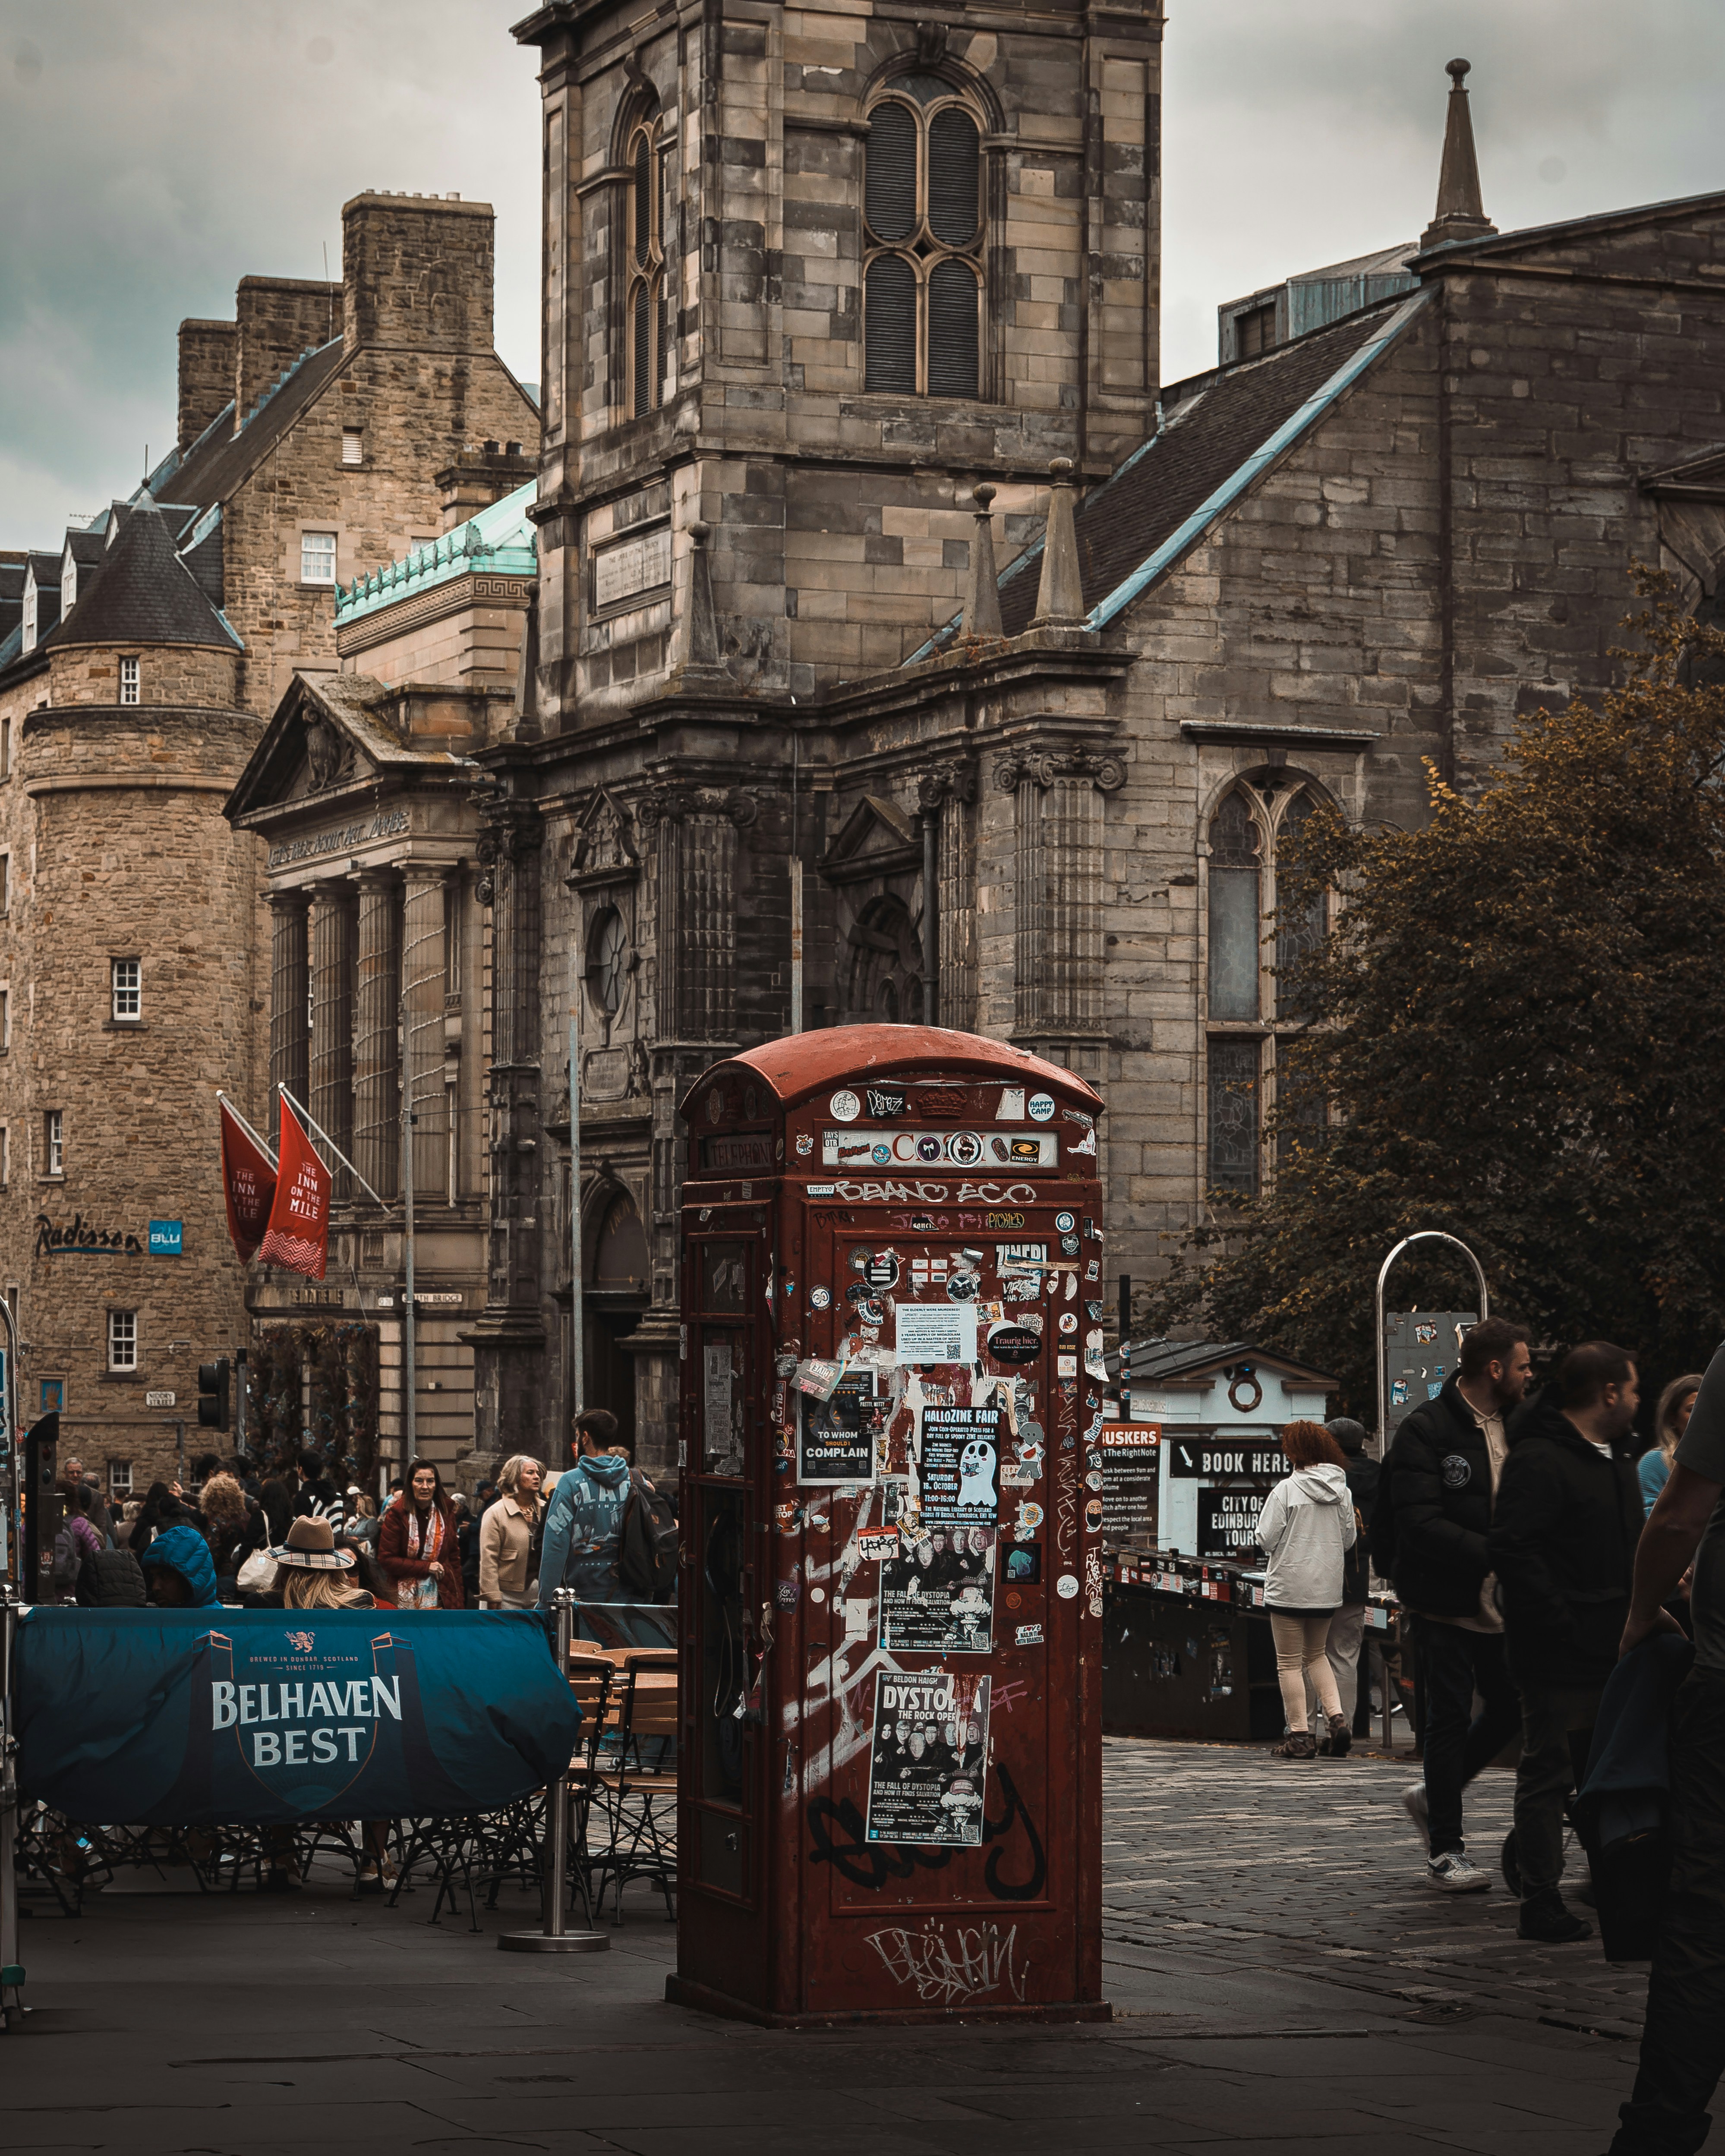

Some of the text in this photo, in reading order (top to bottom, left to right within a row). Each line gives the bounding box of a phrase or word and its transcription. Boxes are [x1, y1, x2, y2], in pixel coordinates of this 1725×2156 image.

[236, 1171, 254, 1182] THE
[302, 1163, 317, 1177] THE
[232, 1180, 255, 1195] INN
[298, 1173, 318, 1191] INN
[243, 1197, 260, 1207] THE
[291, 1186, 321, 1205] ON THE
[238, 1206, 257, 1219] ILE
[289, 1199, 319, 1220] MILE
[36, 1213, 180, 1260] Radisson BLU
[994, 1336, 1038, 1346] Traurig hier.
[924, 1409, 998, 1423] HALLOZINE FAIR
[806, 1448, 868, 1458] COMPLAIN
[1107, 1449, 1121, 1457] The
[1122, 1449, 1140, 1458] Right
[1202, 1453, 1290, 1473] BOOK HERE
[927, 1472, 954, 1481] SATURDAY
[933, 1481, 958, 1490] OCTOBER
[1222, 1496, 1264, 1512] CITY OF
[1211, 1513, 1259, 1529] EDINBUR
[913, 1530, 928, 1543] THC
[893, 1675, 938, 1684] BELDON HAIGH
[211, 1675, 403, 1731] BELHAVEN
[898, 1710, 934, 1720] THE ROCK
[252, 1727, 366, 1767] BEST
[874, 1781, 886, 1789] THE
